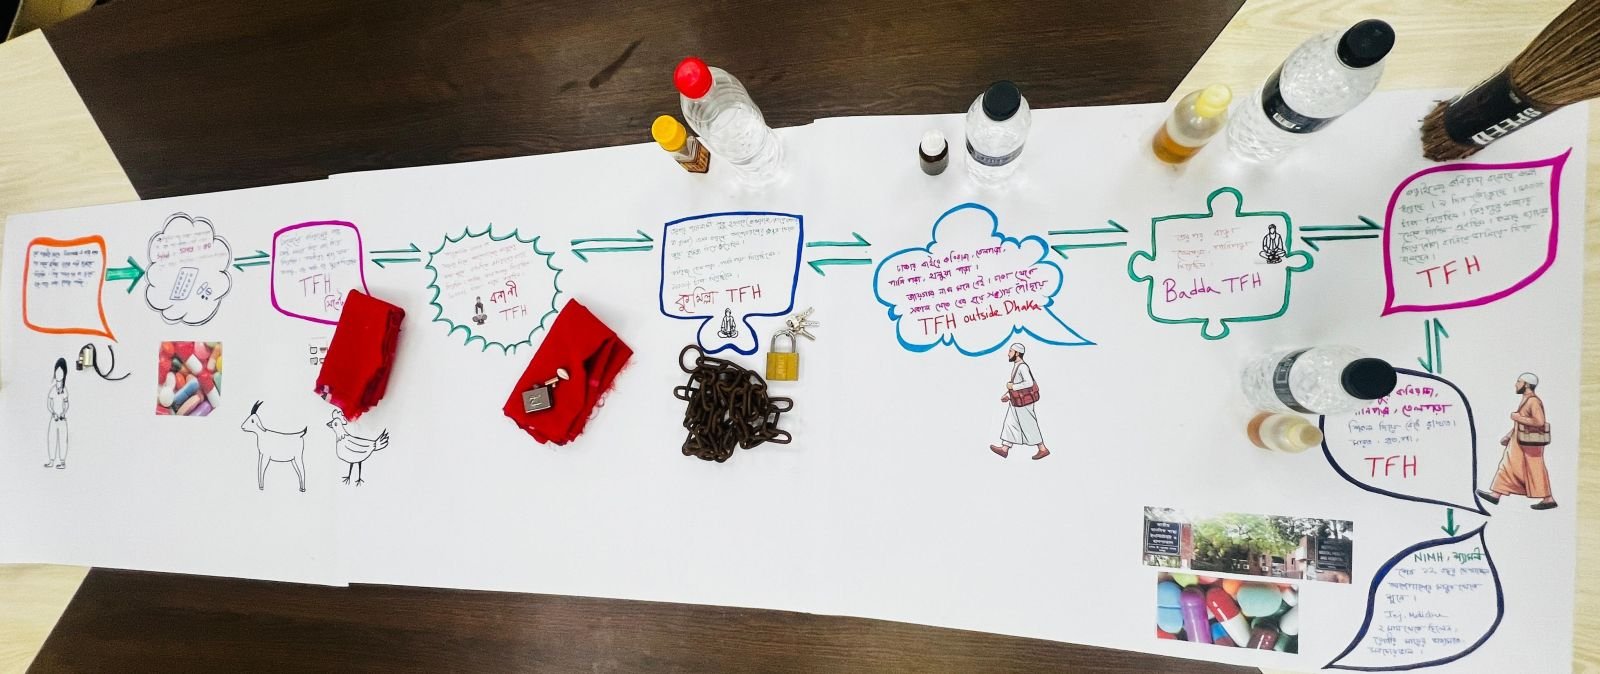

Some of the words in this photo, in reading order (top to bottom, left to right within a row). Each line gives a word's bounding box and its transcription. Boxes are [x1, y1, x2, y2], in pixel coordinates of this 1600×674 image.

[1416, 255, 1481, 288] TFH
[299, 273, 330, 296] TFH
[725, 283, 761, 303] TFH
[1163, 278, 1221, 302] Badda
[1221, 272, 1261, 293] TFH
[498, 304, 527, 321] TFH
[918, 313, 956, 335] TFH
[964, 305, 1003, 324] outside
[1364, 455, 1417, 478] TFH
